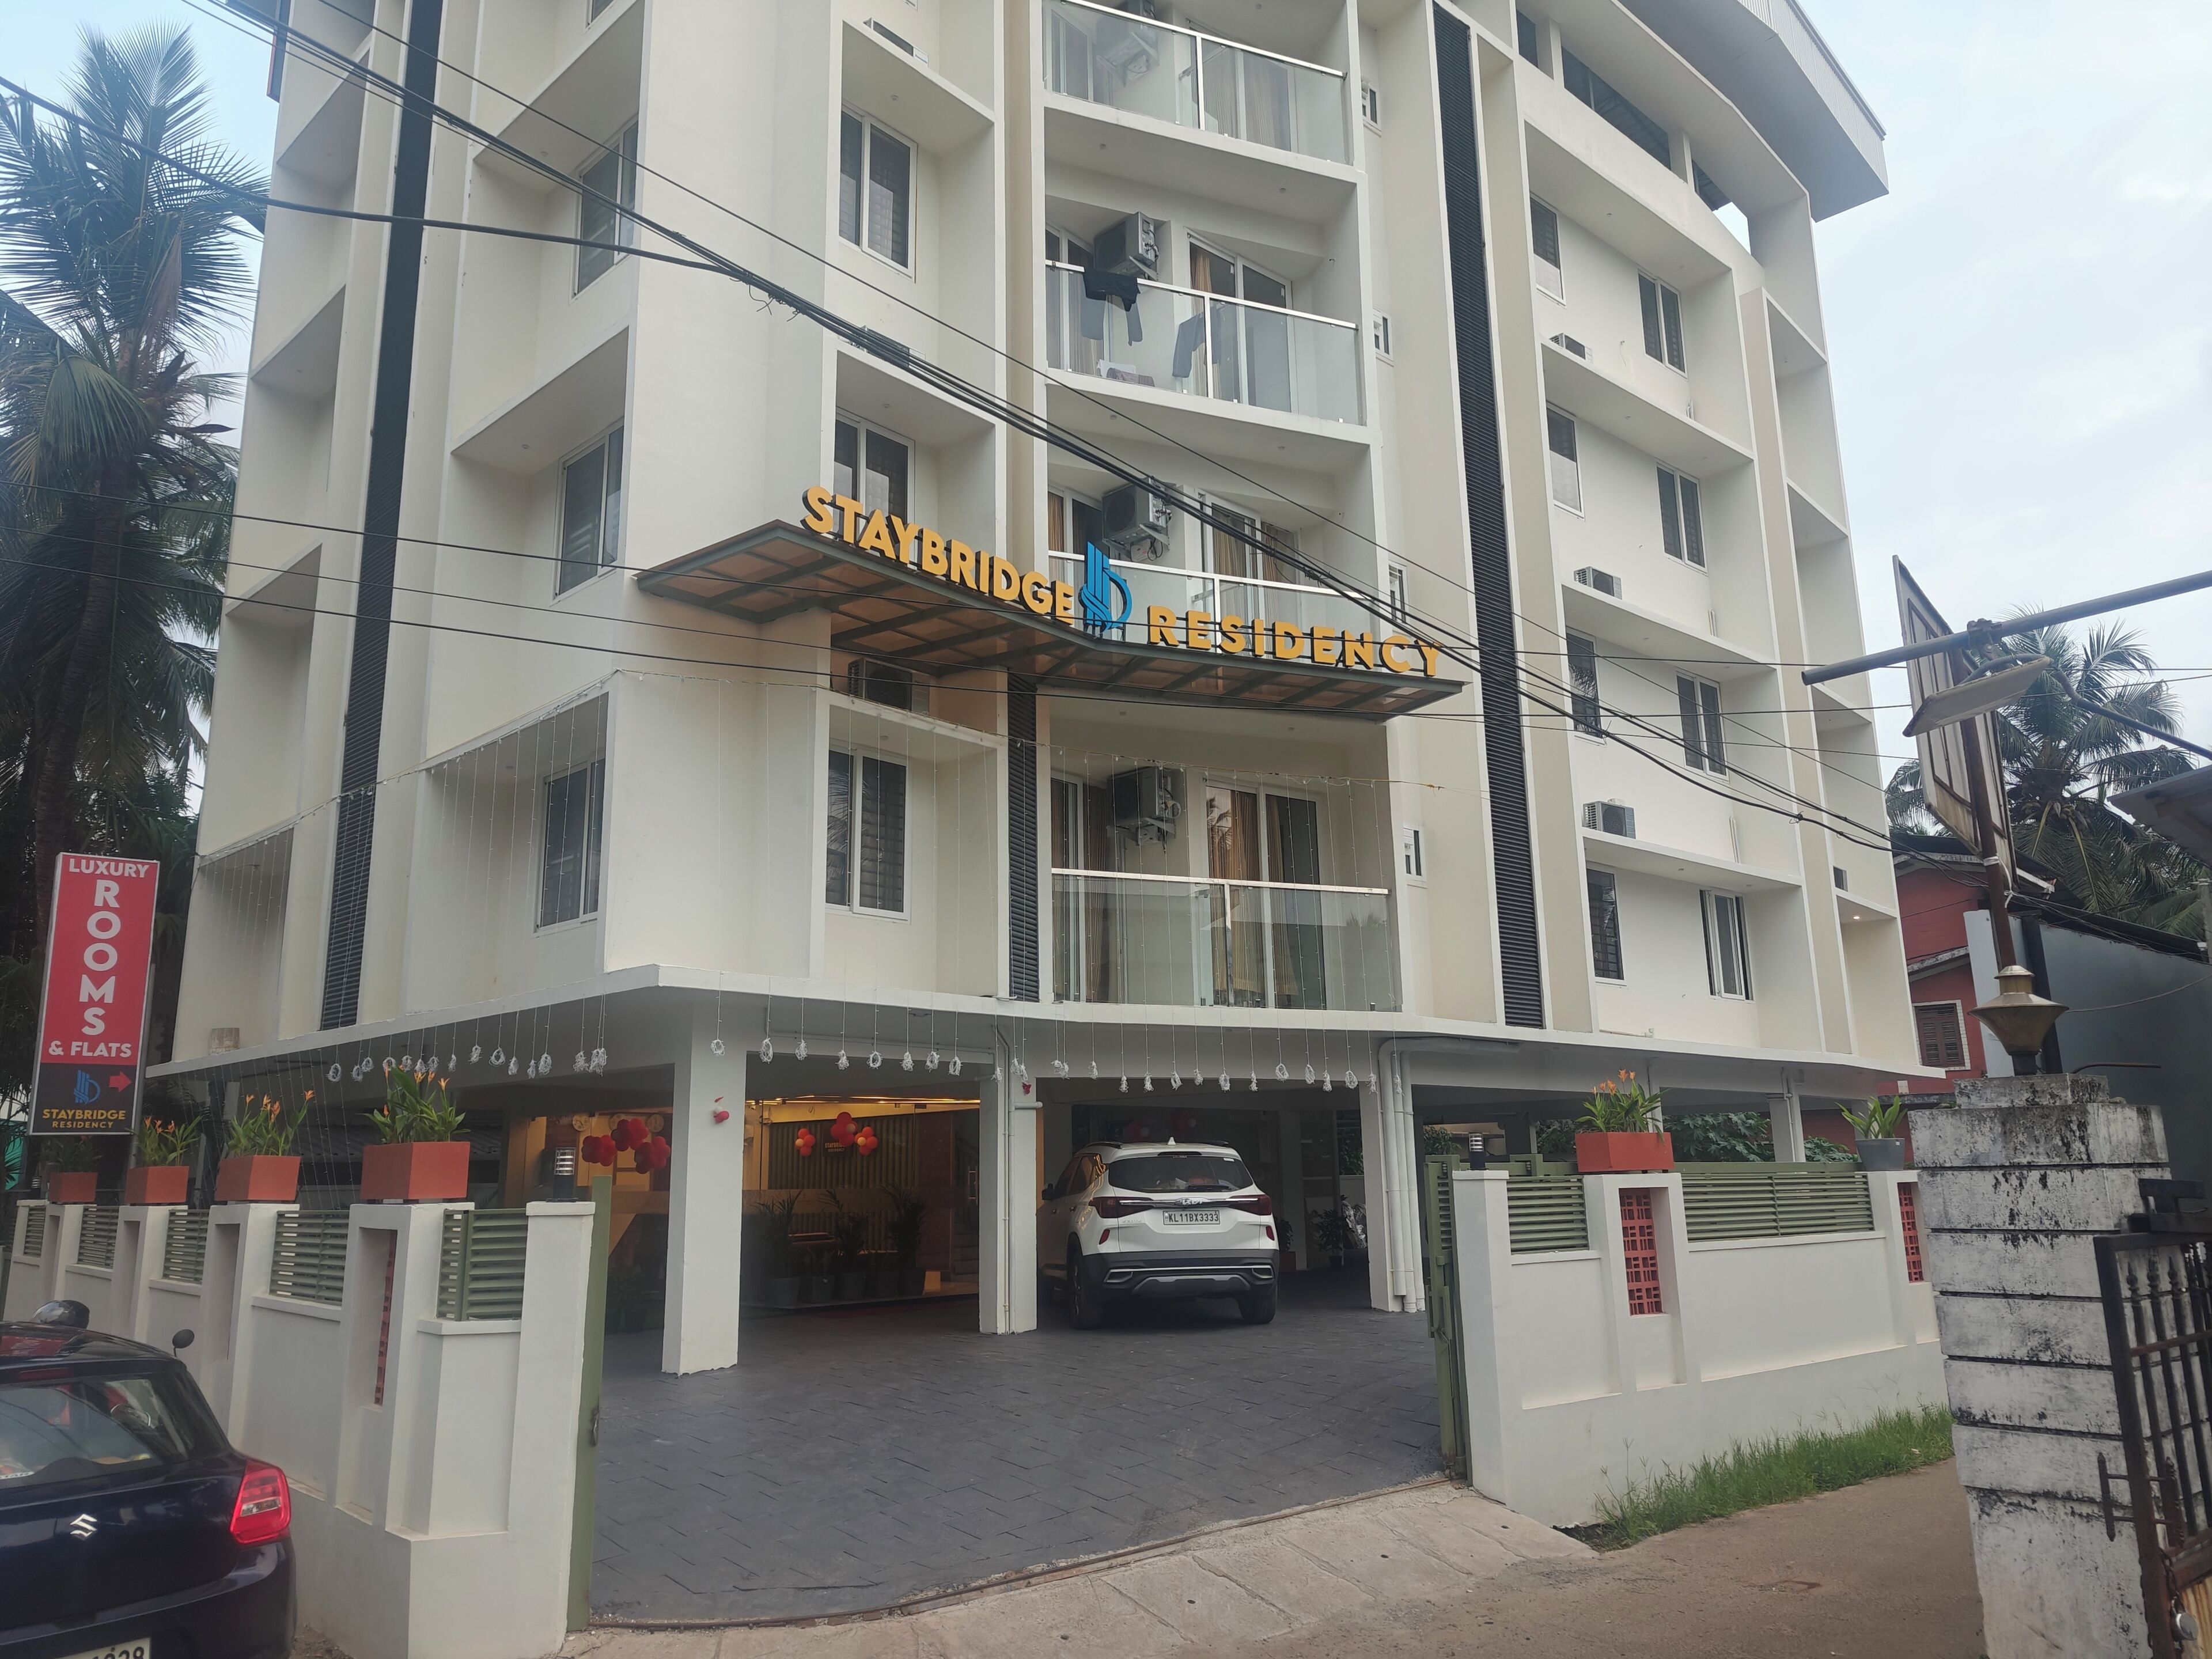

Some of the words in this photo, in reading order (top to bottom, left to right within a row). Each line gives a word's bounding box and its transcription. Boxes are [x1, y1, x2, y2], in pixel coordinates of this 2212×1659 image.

[801, 486, 1074, 625] STAYBRIDGE
[1147, 605, 1440, 677] RESIDENCY
[69, 858, 149, 878] LUXURY
[79, 879, 121, 1036] ROOMS
[48, 1041, 64, 1056] &
[70, 1041, 132, 1058] FLATS
[43, 1108, 126, 1120] STAYBRIDGE
[1168, 1213, 1219, 1222] KL11BX3333
